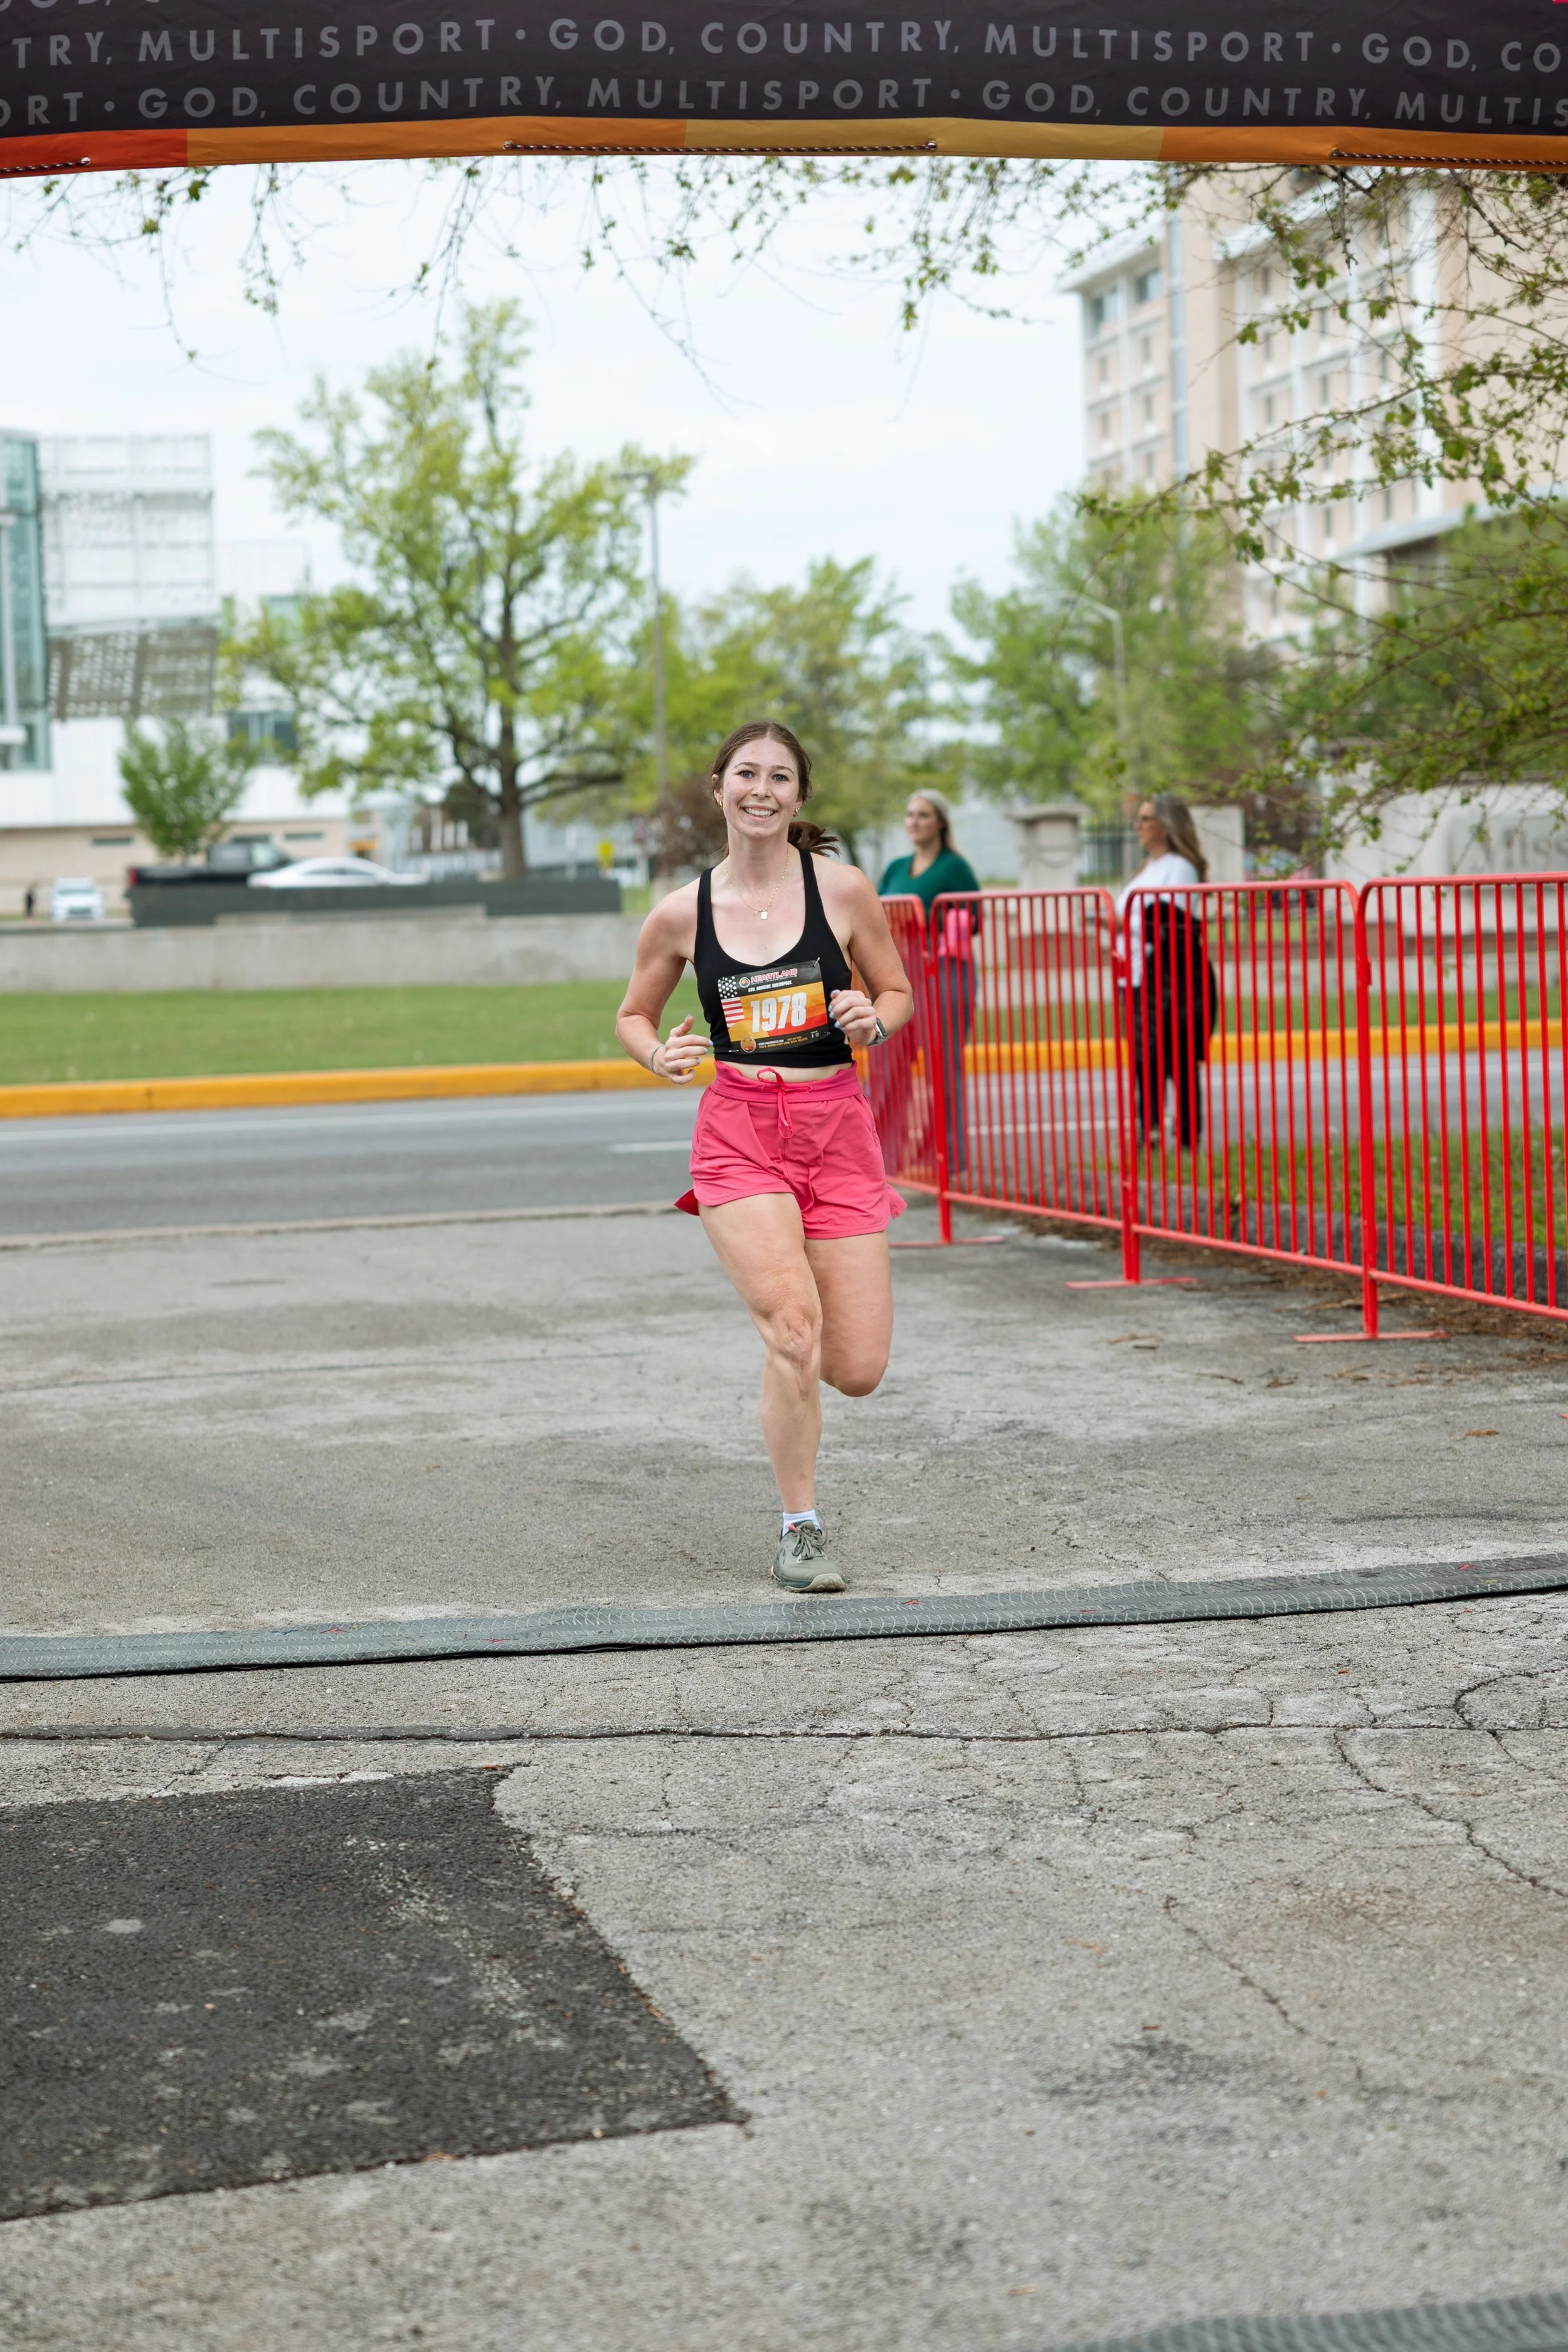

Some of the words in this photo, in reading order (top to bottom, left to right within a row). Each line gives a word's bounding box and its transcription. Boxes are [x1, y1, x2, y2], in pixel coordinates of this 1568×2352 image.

[11, 31, 112, 68] TRY,
[137, 18, 495, 62] MULTISPORT
[549, 18, 675, 55] GOD,
[700, 21, 960, 55] COUNTRY,
[983, 23, 1314, 63] MULTISPORT
[1362, 33, 1477, 72] GOD,
[1500, 41, 1561, 73] CO
[137, 83, 266, 119] GOD,
[293, 75, 561, 115] COUNTRY,
[586, 78, 932, 110] MULTISPORT
[982, 80, 1102, 117] GOD,
[1126, 86, 1371, 120] COUNTRY,
[1394, 91, 1568, 125] MULTIS
[751, 968, 798, 983] HEARTLAND
[750, 992, 807, 1033] 1978
